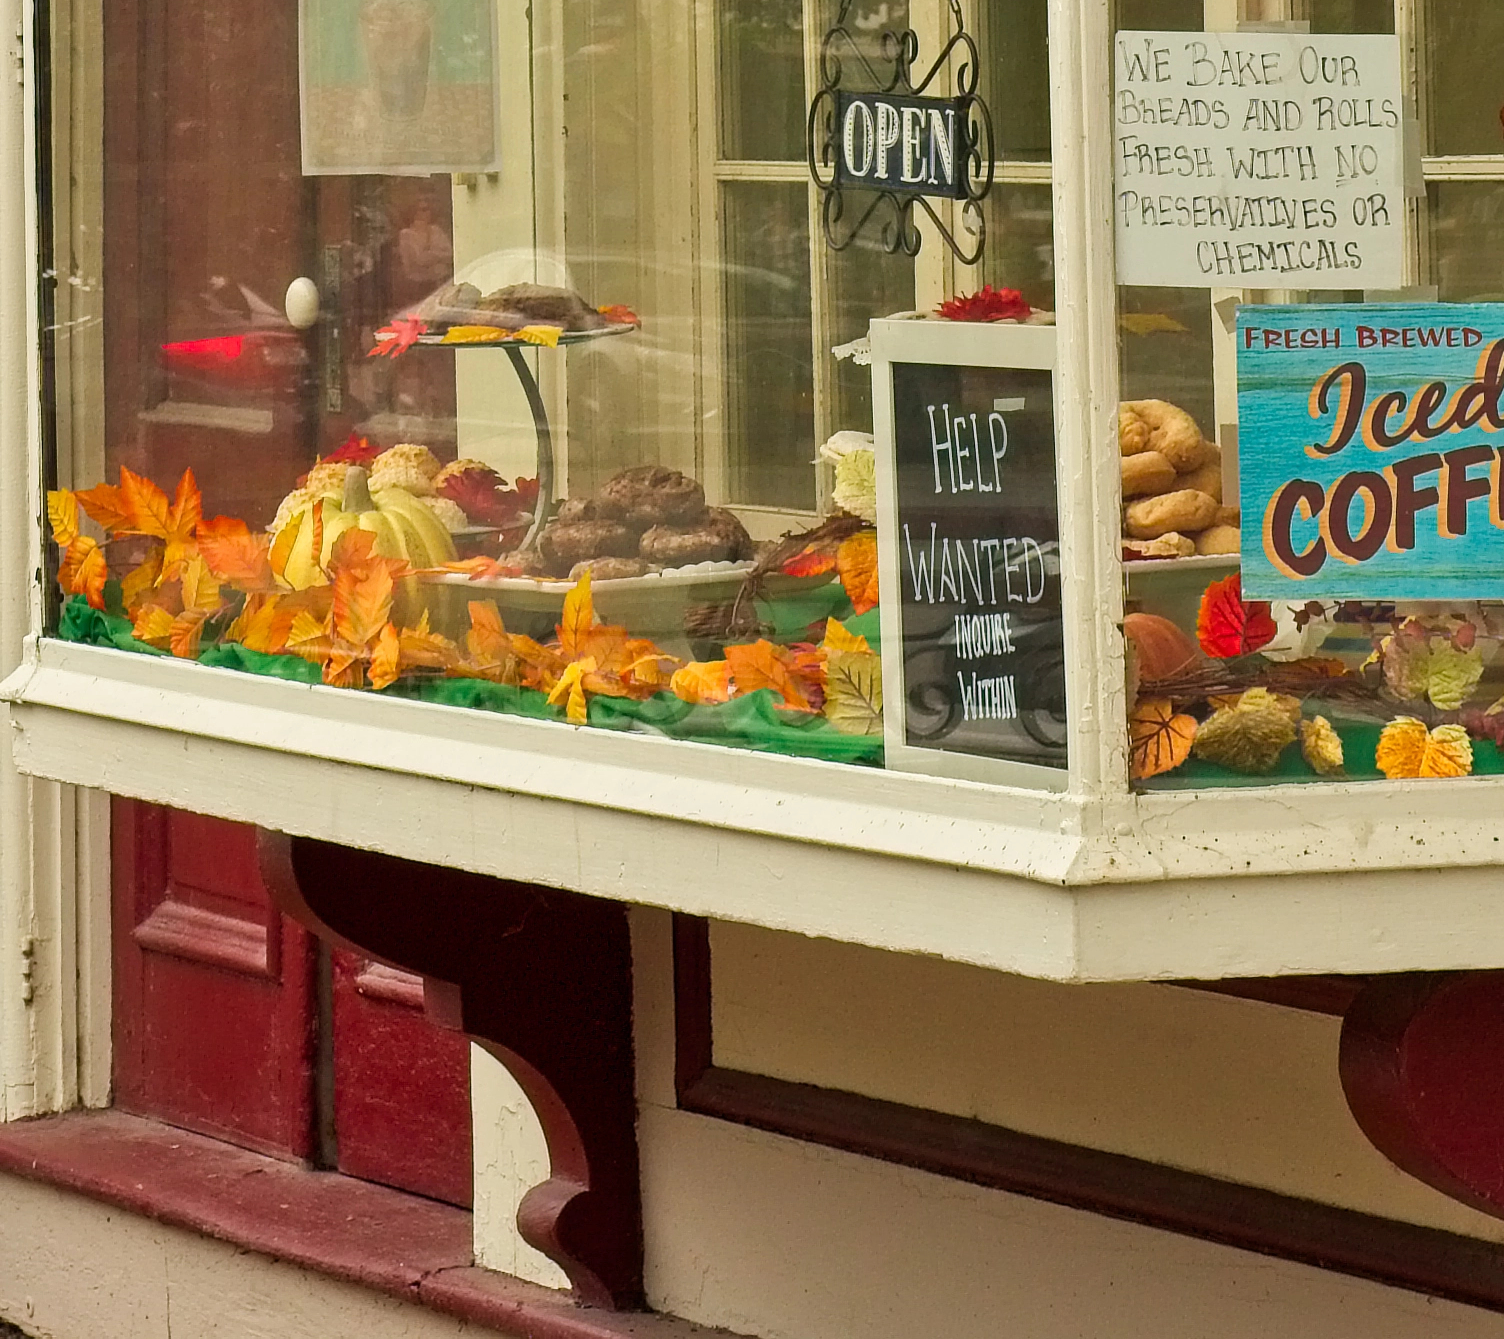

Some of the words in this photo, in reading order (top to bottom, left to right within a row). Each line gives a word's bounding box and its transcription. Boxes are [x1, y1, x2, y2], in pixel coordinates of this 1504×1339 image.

[1119, 38, 1172, 84] WE
[1185, 40, 1283, 87] BAKE
[1299, 45, 1361, 87] OUR
[1118, 88, 1231, 130] BREADS
[1242, 98, 1303, 131] AND
[1312, 96, 1400, 131] ROLLS
[843, 99, 956, 187] OPEN
[1119, 134, 1213, 178] FRESH
[1226, 144, 1317, 182] WITH
[1336, 143, 1379, 179] NO
[1118, 189, 1337, 231] PRESERVATIVES
[1352, 192, 1391, 227] OR
[1196, 239, 1363, 275] CHEMICALS
[1244, 327, 1341, 350] FRESH
[1355, 325, 1484, 350] BREWED
[927, 402, 1008, 495] HELP
[903, 521, 1046, 606] WANTED
[954, 612, 1017, 661] INQUIRE
[956, 669, 1018, 722] WITHIN
